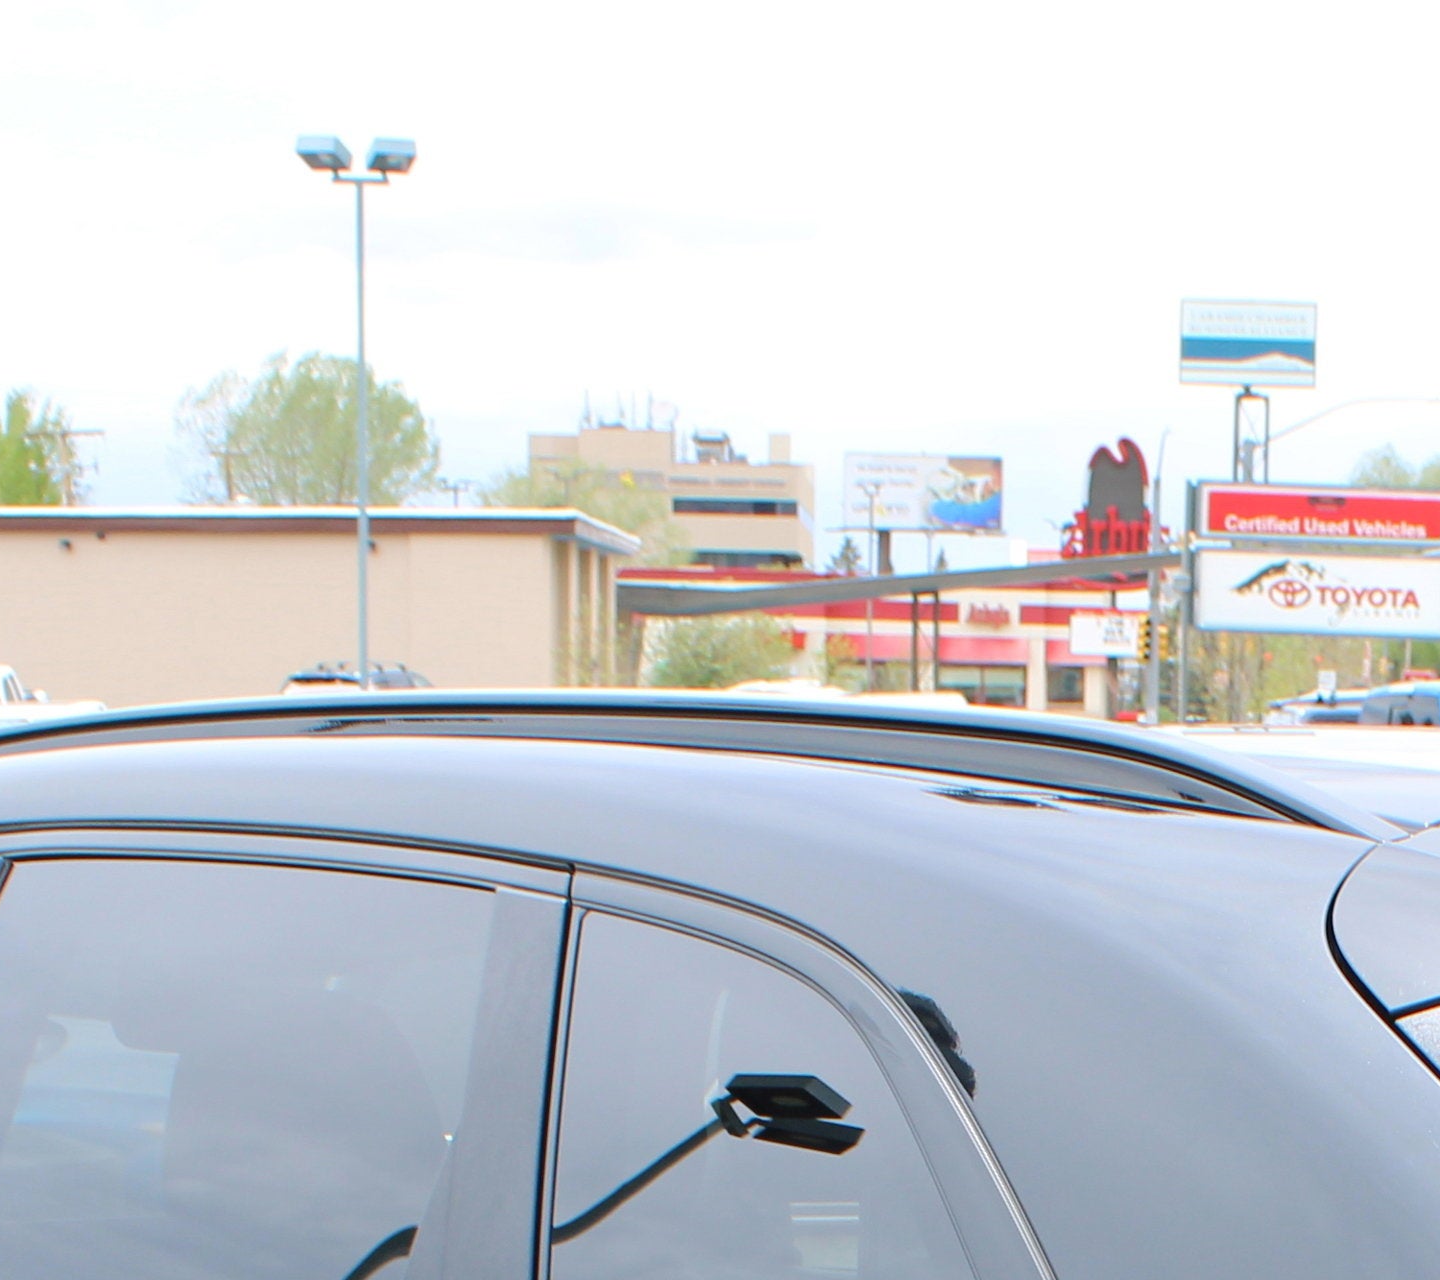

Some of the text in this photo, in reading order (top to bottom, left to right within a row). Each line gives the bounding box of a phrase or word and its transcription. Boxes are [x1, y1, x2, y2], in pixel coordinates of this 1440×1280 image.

[1224, 513, 1426, 539] Certified Used Vehicles
[1317, 587, 1420, 609] TOYOTA
